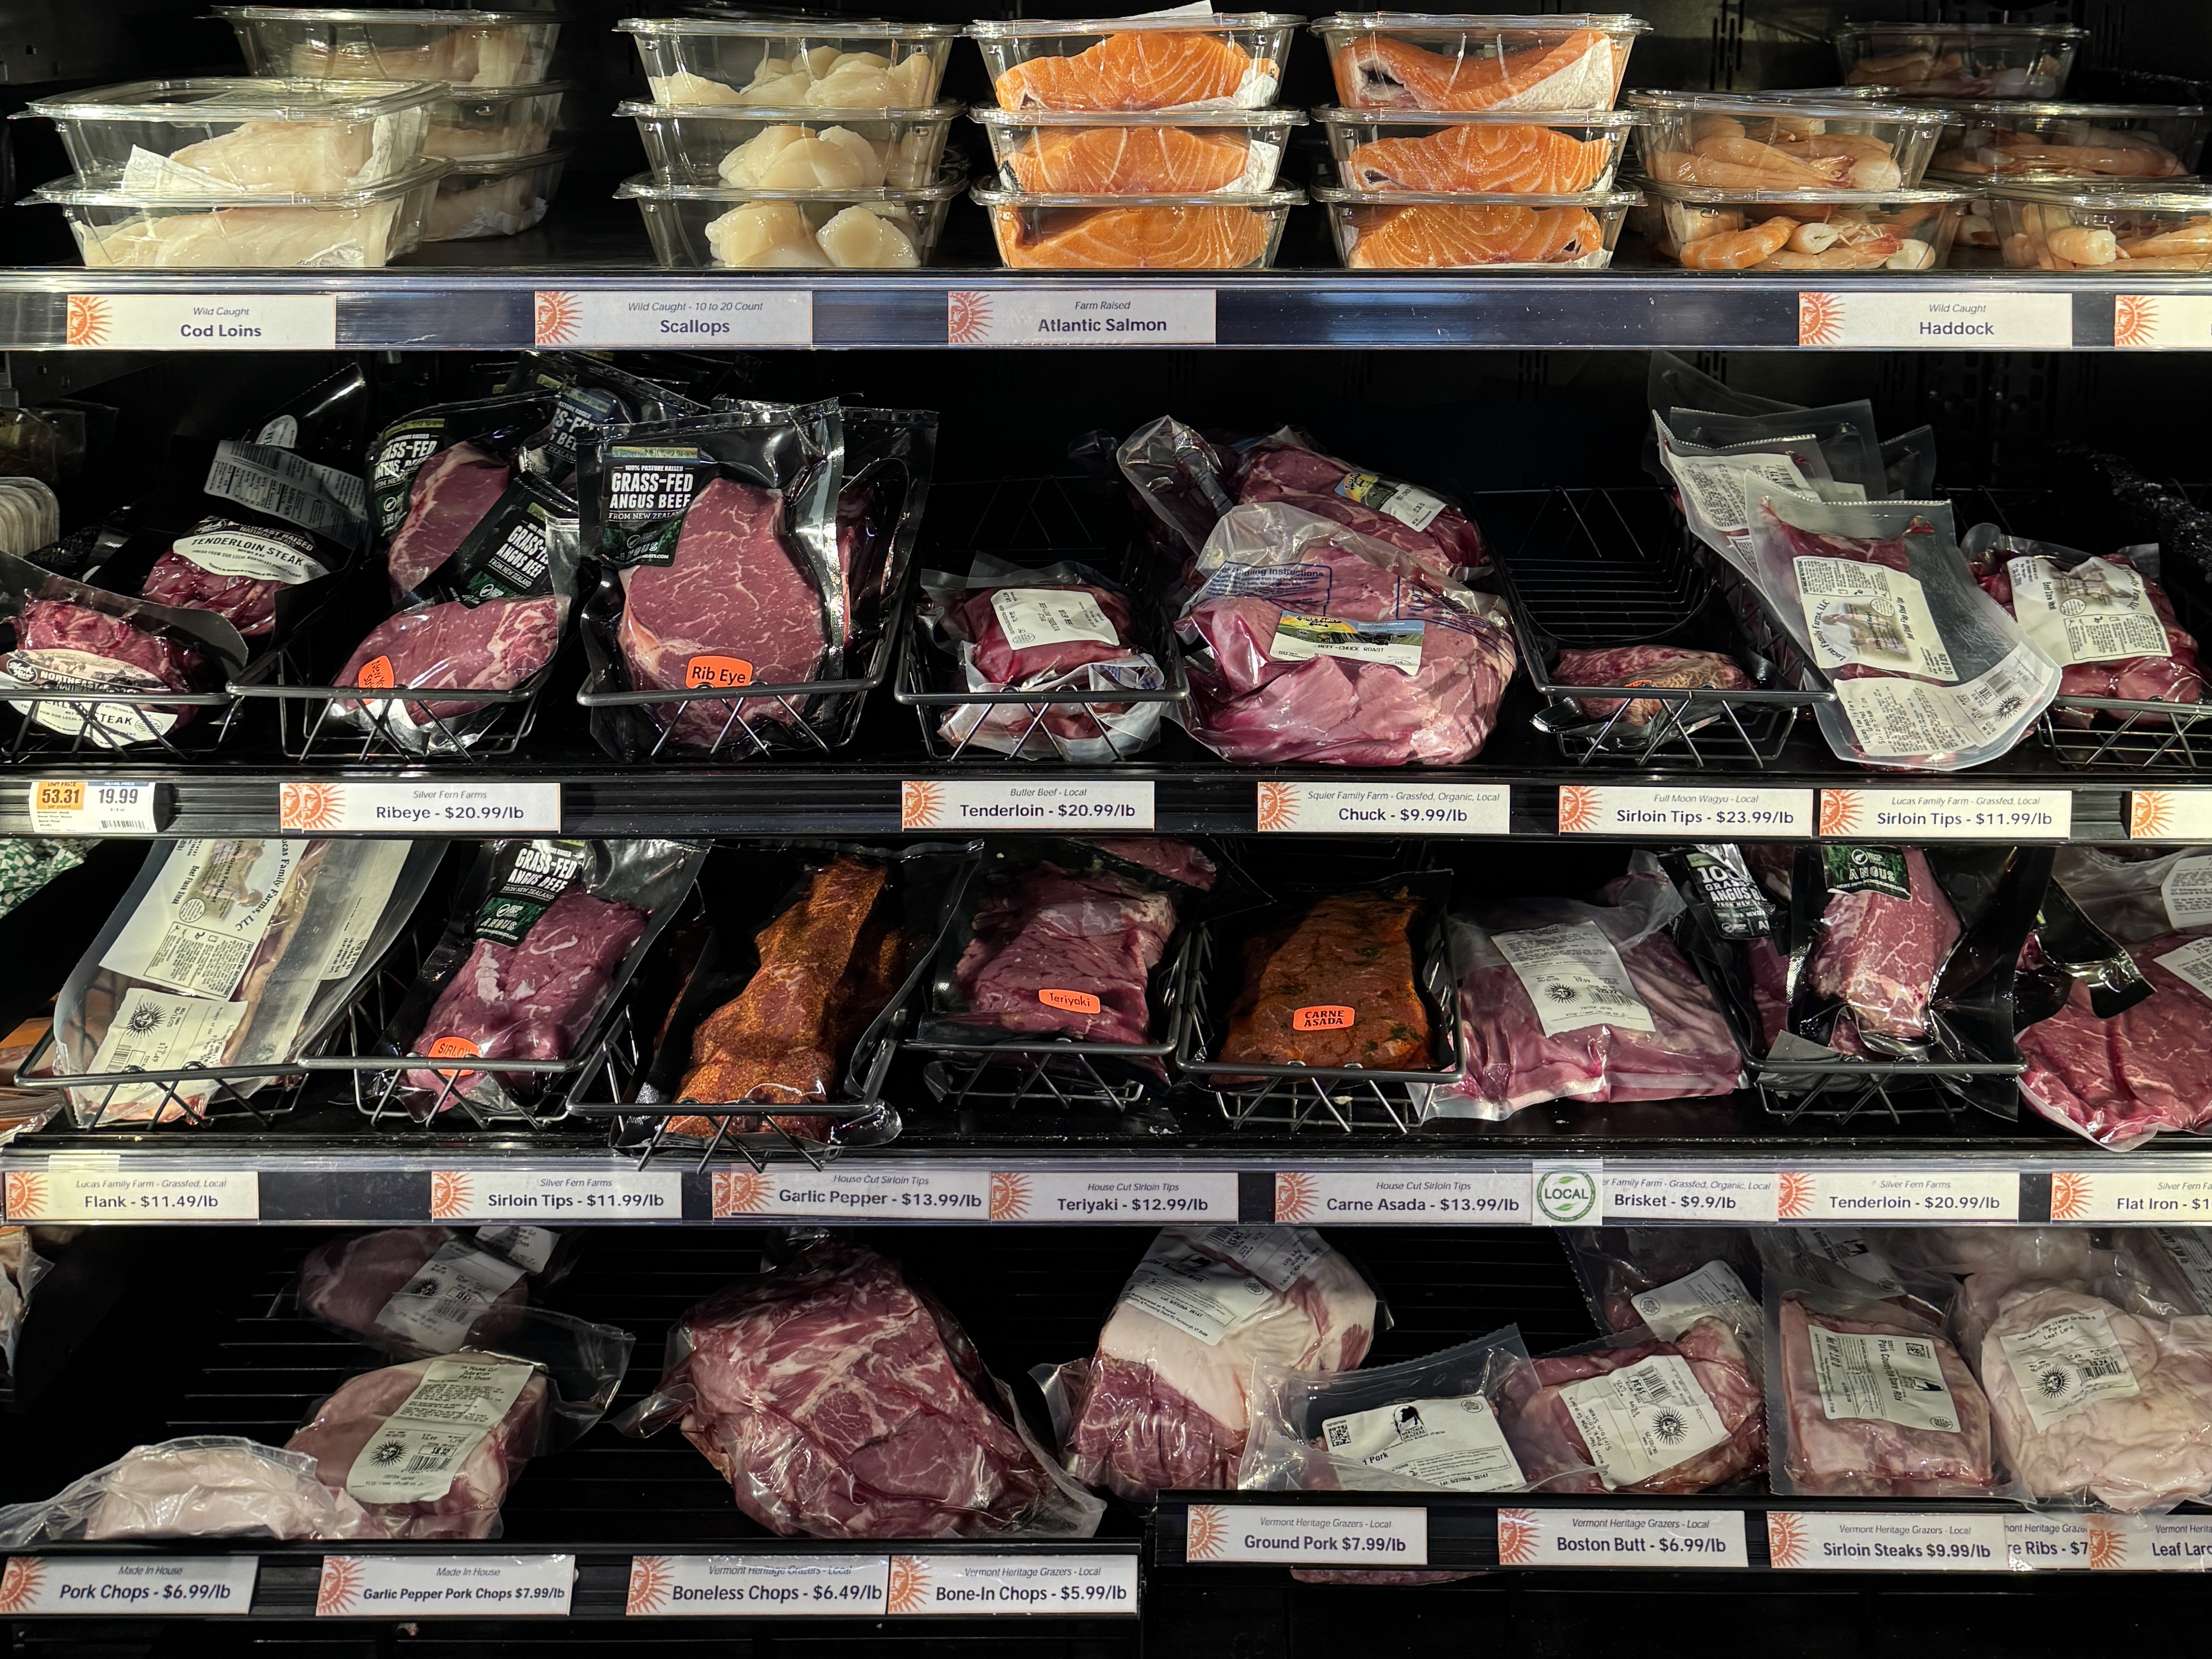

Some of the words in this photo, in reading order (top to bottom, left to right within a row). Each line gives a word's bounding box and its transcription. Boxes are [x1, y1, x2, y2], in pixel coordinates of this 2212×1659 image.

[193, 307, 214, 315] Wild
[216, 307, 250, 318] Caught
[628, 302, 650, 311] Wild
[652, 302, 686, 313] Caught
[695, 302, 707, 311] 10
[720, 302, 733, 311] 20
[735, 302, 763, 311] Count
[1075, 301, 1098, 310] Farm
[1100, 301, 1131, 310] Raised
[1929, 303, 1951, 313] Wild
[1952, 304, 1986, 315] Caught
[180, 324, 214, 337] Cod
[218, 324, 262, 337] Loins
[660, 319, 730, 336] Scallops
[1038, 318, 1101, 332] Atlantic
[1105, 318, 1167, 332] Salmon
[1920, 321, 1995, 335] Haddock
[611, 472, 694, 493] GRASS-FED
[609, 494, 655, 509] ANGUS
[658, 494, 691, 509] BEEF
[192, 537, 265, 552] TENDERLOIN
[266, 548, 304, 566] STEAK
[495, 543, 524, 569] ANGUS
[523, 556, 546, 578] BEEF
[1817, 599, 1831, 611] LLC
[1813, 629, 1829, 650] Family
[1826, 647, 1847, 662] Lucas
[692, 665, 716, 681] Rib
[719, 668, 746, 685] Eye
[42, 789, 80, 804] 53.31
[98, 788, 138, 804] 19.99
[413, 790, 437, 799] Silver
[439, 790, 459, 799] Fern
[461, 790, 487, 799] Farms
[1010, 788, 1036, 796] Butler
[1037, 788, 1058, 796] Beef
[1064, 788, 1087, 796] Local
[1308, 791, 1336, 801] Squier
[1337, 791, 1365, 802] Family
[1366, 791, 1389, 800] Farm
[1653, 794, 1670, 802] Full
[1671, 794, 1697, 803] Moon
[1699, 794, 1729, 805] Wagyu
[1735, 794, 1759, 803] Local
[1891, 797, 1916, 805] Lucas
[1918, 797, 1946, 807] Family
[377, 806, 431, 822] Ribeye
[445, 806, 524, 820] $20.99/lb
[960, 804, 1044, 817] Tenderloin
[1058, 803, 1135, 817] $20.99/lb
[1339, 807, 1387, 821] Chuck
[1400, 808, 1468, 822] $9.99/lb
[1616, 810, 1666, 822] Sirloin
[1670, 810, 1702, 826] Tips
[1716, 811, 1794, 824] $23.99/lb
[1877, 812, 1926, 825] Sirloin
[1930, 813, 1965, 828] Tips
[1975, 812, 2053, 825] $11.99/lb
[515, 848, 578, 880] GRASS-FED
[273, 858, 290, 888] Family
[507, 868, 543, 886] ANGUS
[538, 876, 568, 893] BEEF
[1849, 866, 1895, 882] ANGUS
[1710, 887, 1751, 902] ANGUS
[235, 915, 255, 932] LLC
[1049, 992, 1090, 1007] Teriyaki
[1305, 1010, 1345, 1019] CARNE
[1304, 1018, 1343, 1027] ASADA
[540, 1178, 564, 1187] Silver
[565, 1178, 585, 1187] Fern
[586, 1178, 612, 1187] Farms
[1116, 1183, 1132, 1191] Cut
[1133, 1183, 1160, 1191] Sirloin
[1162, 1183, 1179, 1193] Tips
[779, 1189, 826, 1203] Garlic
[829, 1191, 888, 1207] Pepper
[901, 1192, 982, 1207] $13.99/lb
[1544, 1187, 1589, 1200] LOCAL
[84, 1195, 127, 1208] Flank
[140, 1195, 219, 1208] $11.49/lb
[488, 1194, 538, 1206] Sirloin
[541, 1194, 574, 1210] Tips
[586, 1194, 664, 1207] $11.99/lb
[1057, 1198, 1118, 1214] Teriyaki
[1132, 1198, 1208, 1211] $12.99/lb
[1327, 1198, 1373, 1211] Carne
[1377, 1198, 1426, 1210] Asada
[1440, 1198, 1519, 1211] $13.99/lb
[1615, 1194, 1667, 1207] Brisket
[1680, 1195, 1736, 1209] $9.9/lb
[1829, 1196, 1911, 1208] Tenderloin
[1924, 1196, 2000, 1209] $20.99/lb
[2117, 1197, 2144, 1210] Flat
[2149, 1198, 2178, 1210] Iron
[1368, 1451, 1389, 1464] Pork
[1261, 1517, 1295, 1526] Vermont
[1296, 1518, 1331, 1529] Heritage
[1332, 1518, 1363, 1528] Grazers
[1370, 1520, 1392, 1529] Local
[1572, 1518, 1608, 1527] Vermont
[1609, 1519, 1646, 1530] Heritage
[1647, 1519, 1680, 1529] Grazers
[1687, 1520, 1710, 1529] Local
[1839, 1524, 1874, 1533] Vermont
[1875, 1525, 1910, 1536] Heritage
[1912, 1525, 1943, 1534] Grazers
[1949, 1525, 1971, 1535] Local
[1244, 1534, 1300, 1549] Ground
[1304, 1536, 1338, 1550] Pork
[1342, 1536, 1406, 1552] $7.99/lb
[1557, 1537, 1611, 1552] Boston
[1614, 1537, 1646, 1552] Butt
[1659, 1537, 1726, 1553] $6.99/lb
[1823, 1542, 1871, 1556] Sirloin
[1874, 1543, 1923, 1557] Steaks
[1926, 1543, 1991, 1558] $9.99/lb
[2025, 1541, 2058, 1555] Ribs
[2152, 1542, 2181, 1556] Leaf
[59, 1584, 97, 1599] Pork
[100, 1584, 150, 1603] Chops
[162, 1584, 231, 1599] $6.99/lb
[363, 1588, 398, 1599] Garlic
[400, 1588, 443, 1602] Pepper
[445, 1588, 473, 1599] Pork
[476, 1587, 512, 1601] Chops
[514, 1587, 565, 1599] $7.99/lb
[672, 1584, 744, 1600] Boneless
[749, 1585, 799, 1604] Chops
[813, 1584, 882, 1601] $6.49/lb
[936, 1586, 995, 1601] Bone-In
[999, 1586, 1047, 1605] Chops
[1060, 1585, 1127, 1601] $5.99/lb
